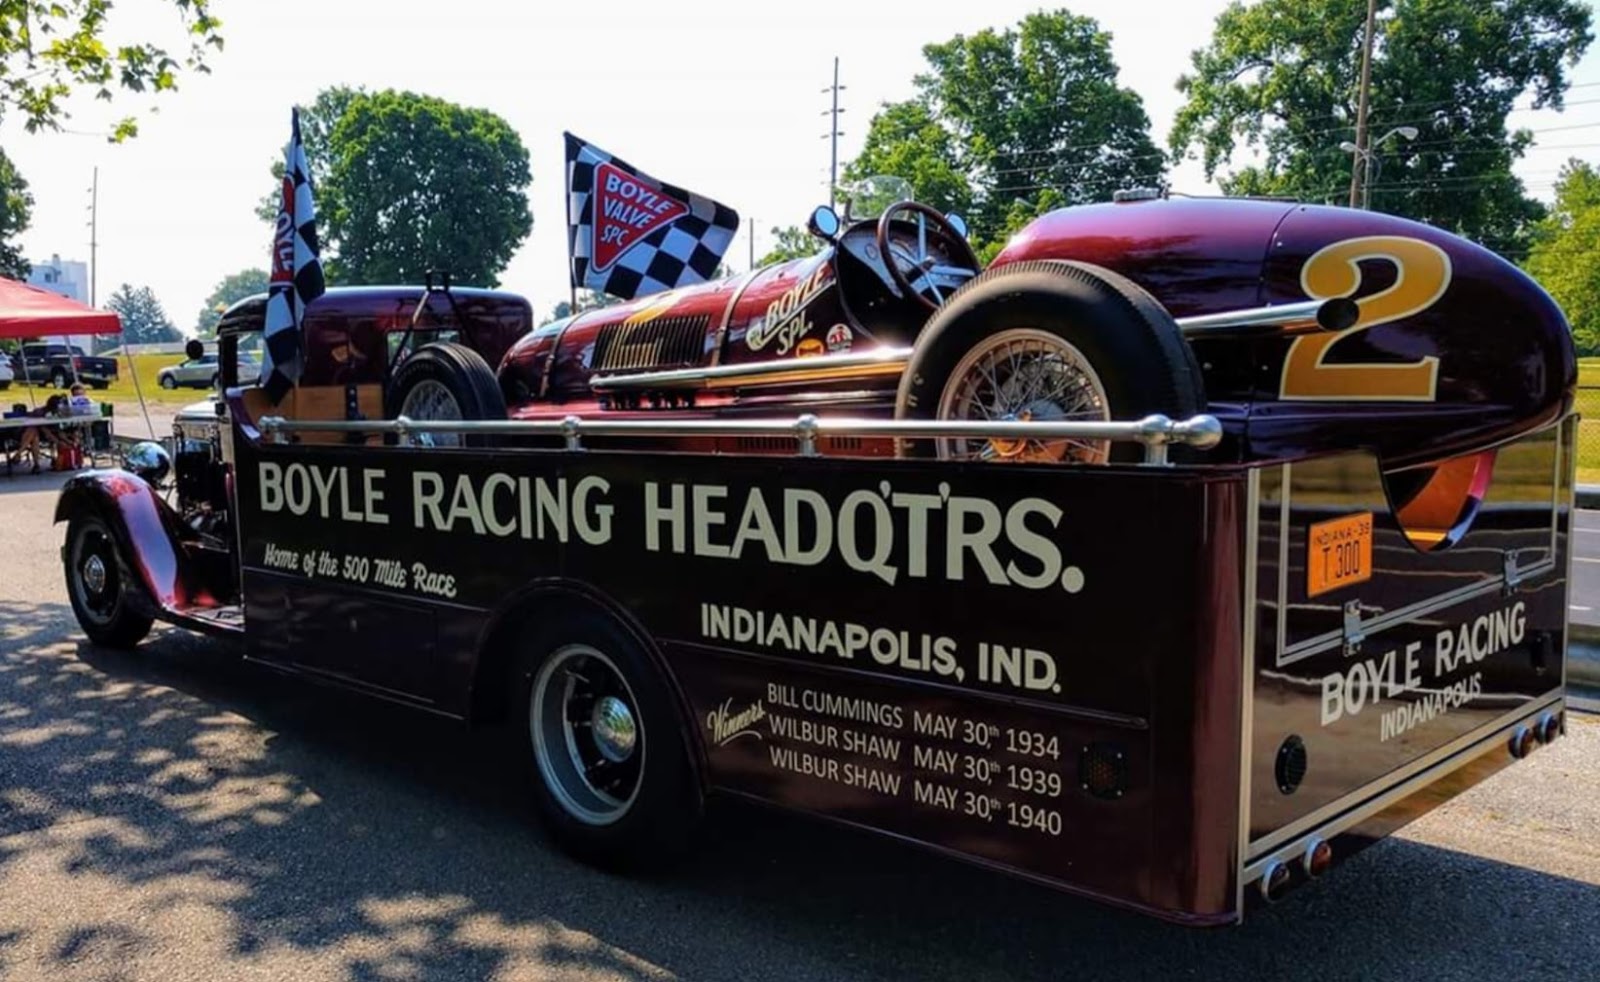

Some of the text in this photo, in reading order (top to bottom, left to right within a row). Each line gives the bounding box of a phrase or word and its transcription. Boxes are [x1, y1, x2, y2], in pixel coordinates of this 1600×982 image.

[603, 196, 656, 229] VALVE
[605, 171, 676, 215] BOYLE
[600, 225, 630, 246] SPC
[764, 260, 829, 336] BOYLE
[1278, 235, 1452, 402] 2
[258, 461, 389, 525] BOYLE
[412, 471, 614, 546] RACING
[263, 543, 457, 599] Home of the 500 Mile Race
[1322, 540, 1360, 582] T 300
[701, 603, 1062, 694] INDIANAPOLIS, IND.
[1320, 601, 1527, 727] BOYLE RACING
[768, 683, 799, 708] BILL
[802, 689, 904, 728] CUMMINGS
[914, 710, 957, 739] MAY
[1006, 728, 1060, 760] 1934
[1380, 672, 1482, 742] INDIANAPOLIS
[768, 714, 838, 749] WILBUR
[843, 730, 901, 762] SHAW
[914, 745, 958, 774] MAY
[1007, 765, 1062, 797] 1939
[769, 745, 839, 781] WILBUR
[843, 765, 901, 796] SHAW
[914, 780, 958, 810] MAY
[1007, 802, 1062, 836] 1940
